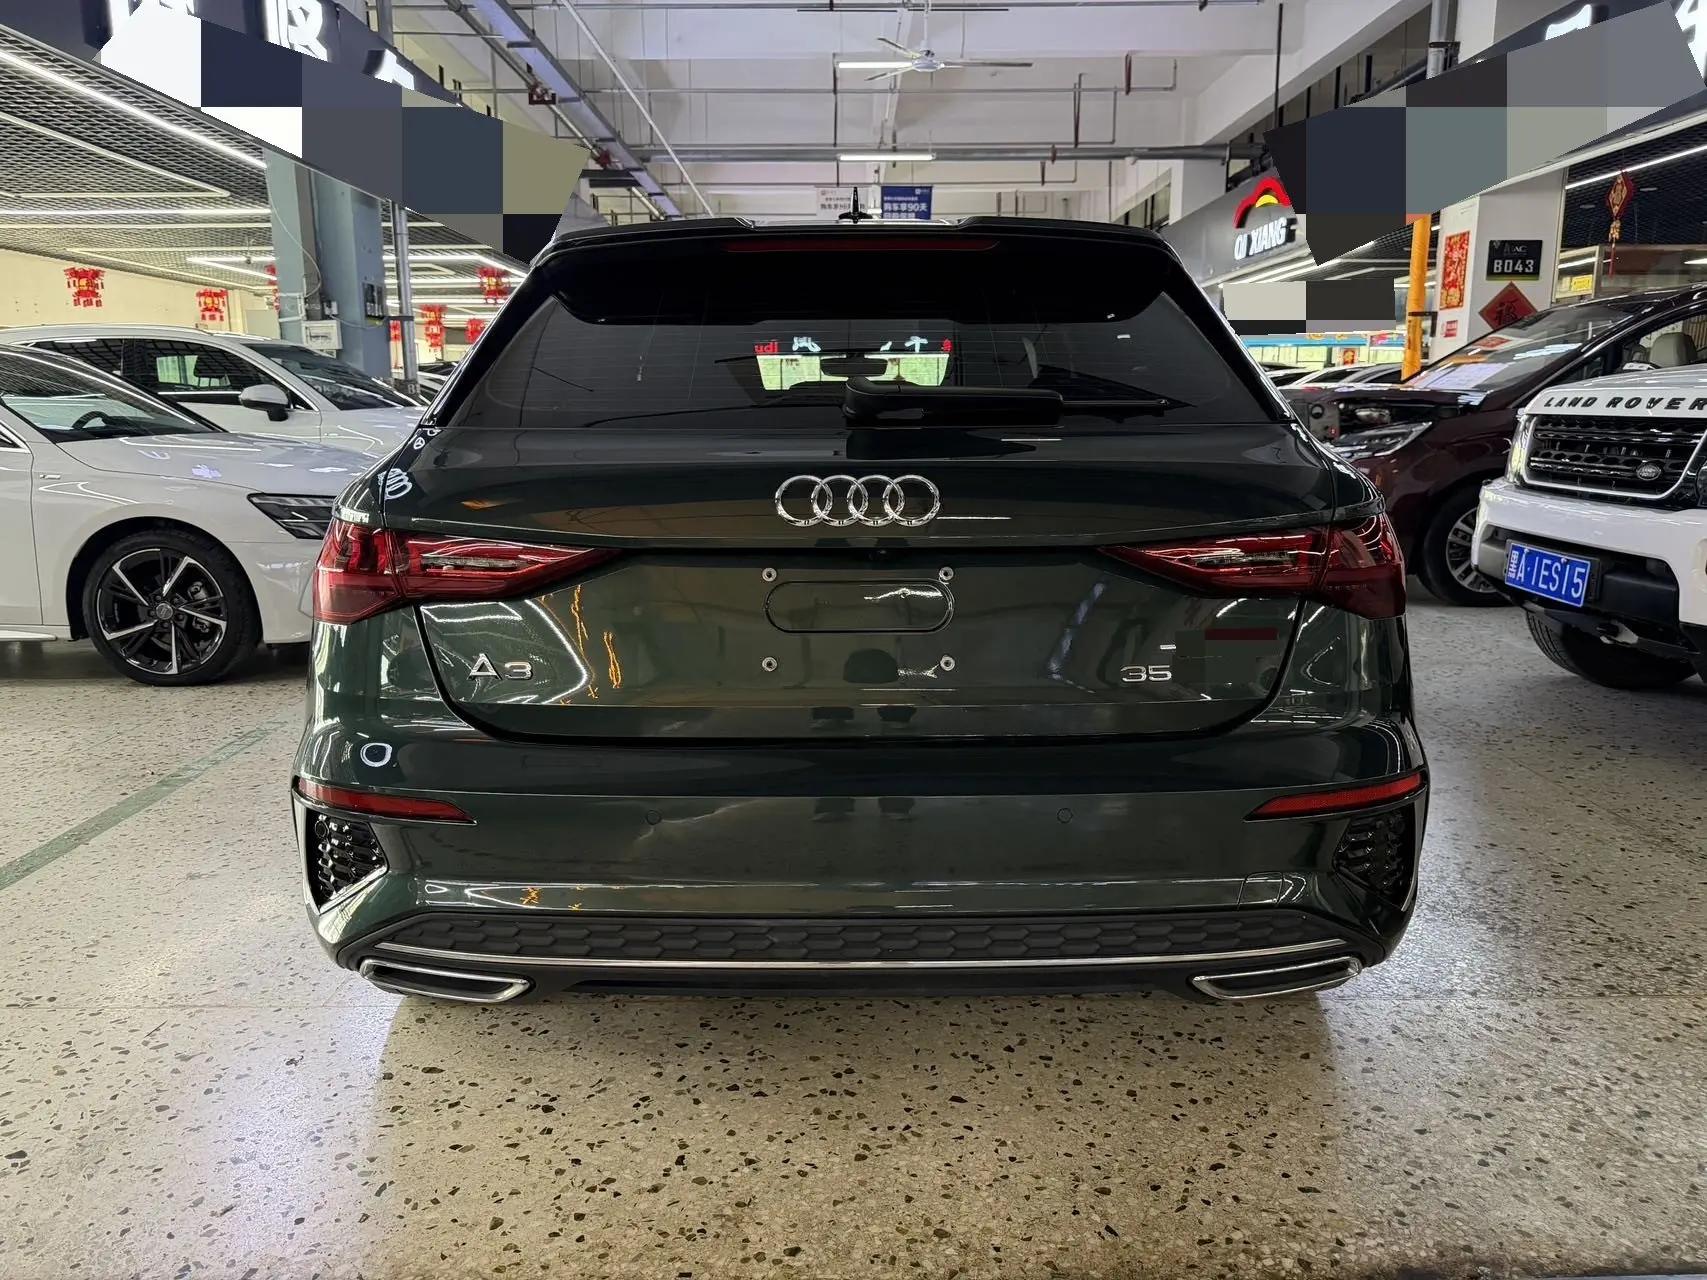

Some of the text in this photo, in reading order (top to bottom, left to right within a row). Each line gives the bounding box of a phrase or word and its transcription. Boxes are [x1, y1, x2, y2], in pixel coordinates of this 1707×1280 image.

[1249, 217, 1287, 256] XIANG
[1493, 259, 1535, 273] B043
[1543, 396, 1707, 411] LAND ROVER
[466, 652, 533, 680] A3
[1120, 664, 1173, 683] 35
